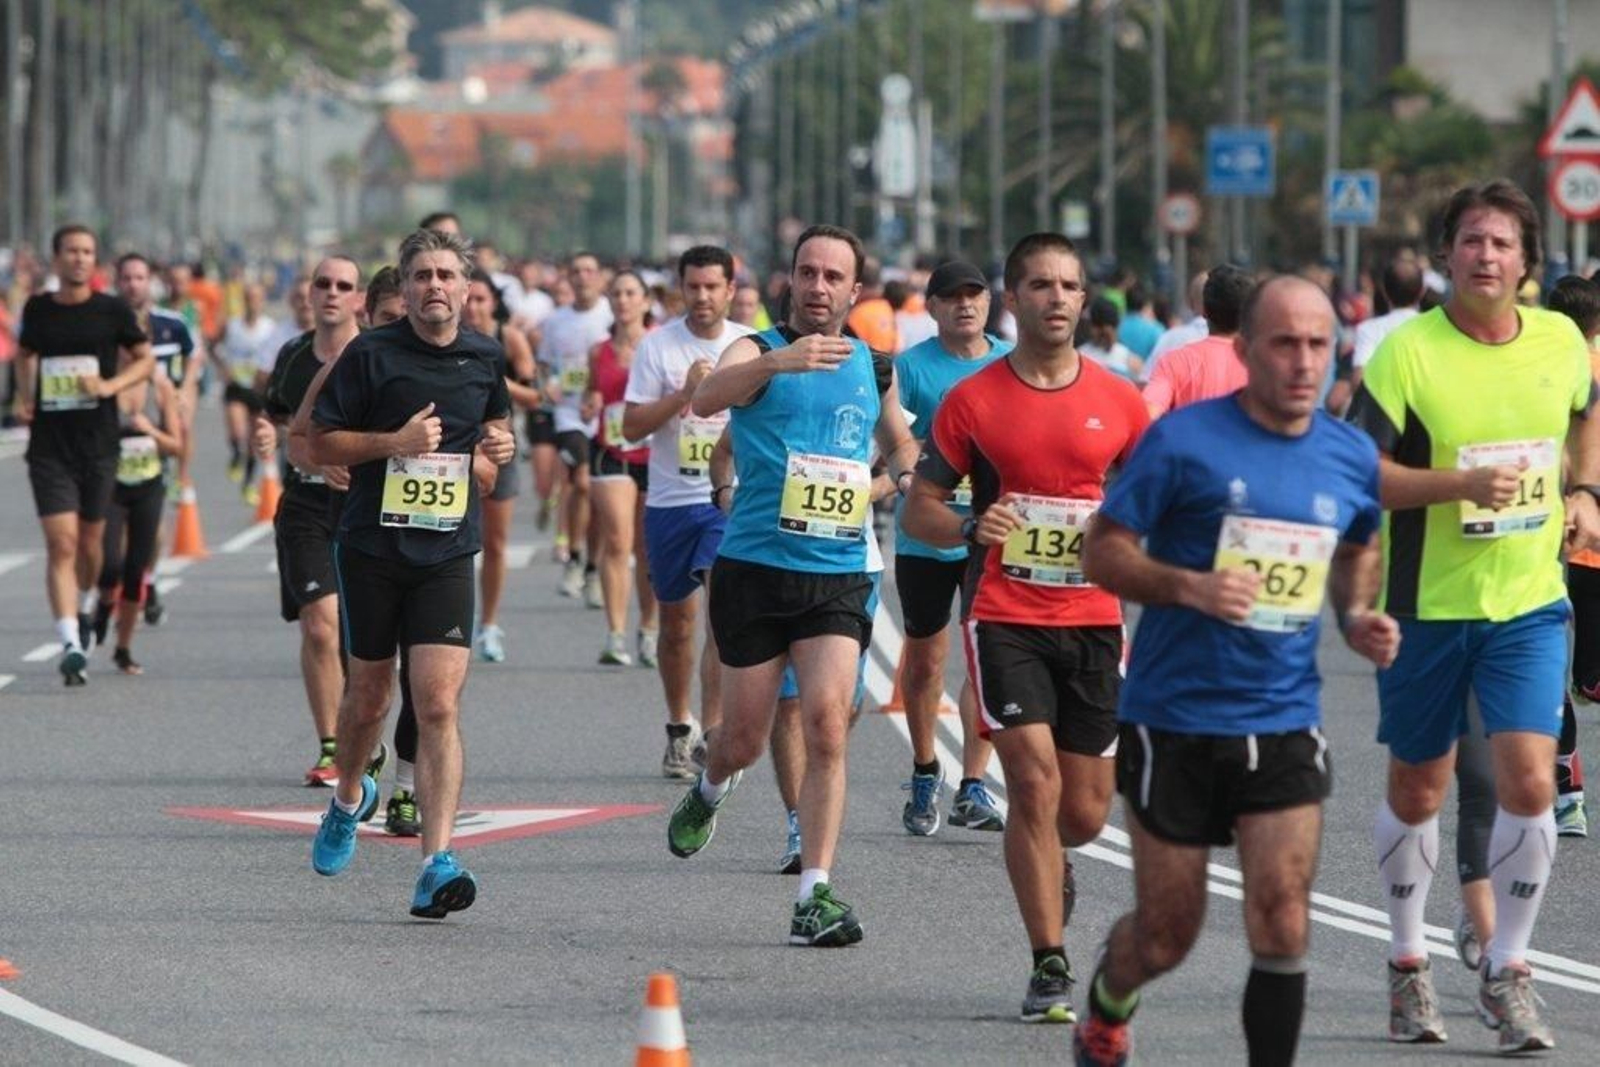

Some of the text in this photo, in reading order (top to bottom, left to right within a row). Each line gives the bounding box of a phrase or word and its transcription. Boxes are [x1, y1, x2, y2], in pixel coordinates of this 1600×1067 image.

[402, 478, 455, 507] 935
[801, 483, 855, 515] 158
[1515, 475, 1546, 508] 14
[1024, 527, 1085, 560] 134
